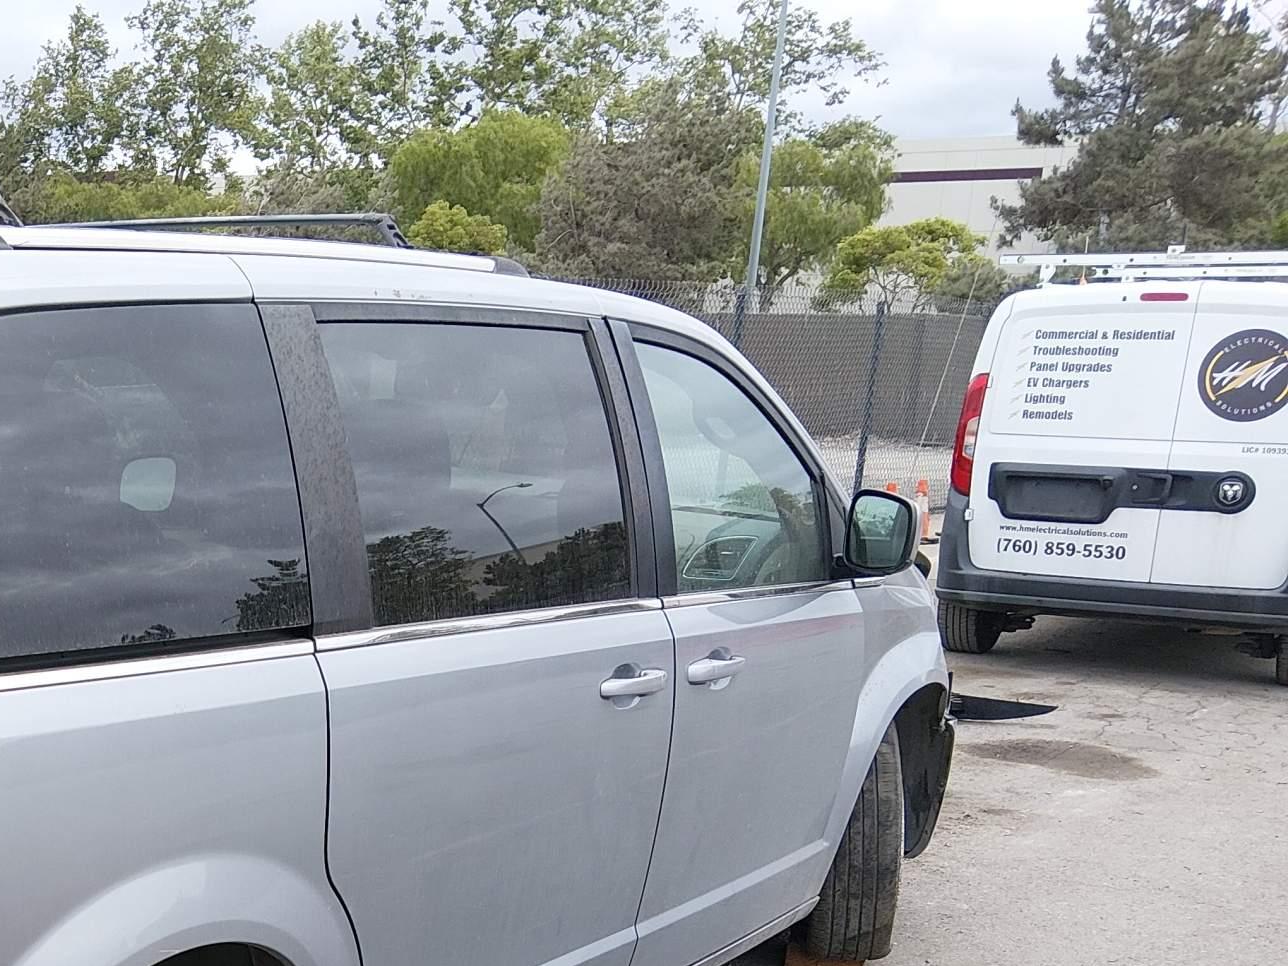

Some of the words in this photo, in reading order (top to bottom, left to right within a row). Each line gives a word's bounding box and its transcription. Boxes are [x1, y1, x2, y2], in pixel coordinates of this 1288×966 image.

[1035, 329, 1098, 340] Commercial
[1101, 331, 1108, 340] &
[1112, 329, 1176, 341] Residential
[1032, 345, 1120, 357] Troubleshooting
[1223, 336, 1285, 354] ELECTRICAL
[1029, 361, 1058, 372] Panel
[1061, 361, 1112, 373] Upgrades
[1027, 377, 1039, 388] EV
[1042, 377, 1090, 389] Chargers
[1024, 393, 1066, 405] Lighting
[1215, 400, 1273, 416] SOLUTIONS
[1022, 409, 1074, 421] Remodels
[999, 524, 1128, 539] www.hmelectricalsolutions.com
[997, 537, 1038, 556] (760)
[1044, 540, 1126, 560] 859-5530
